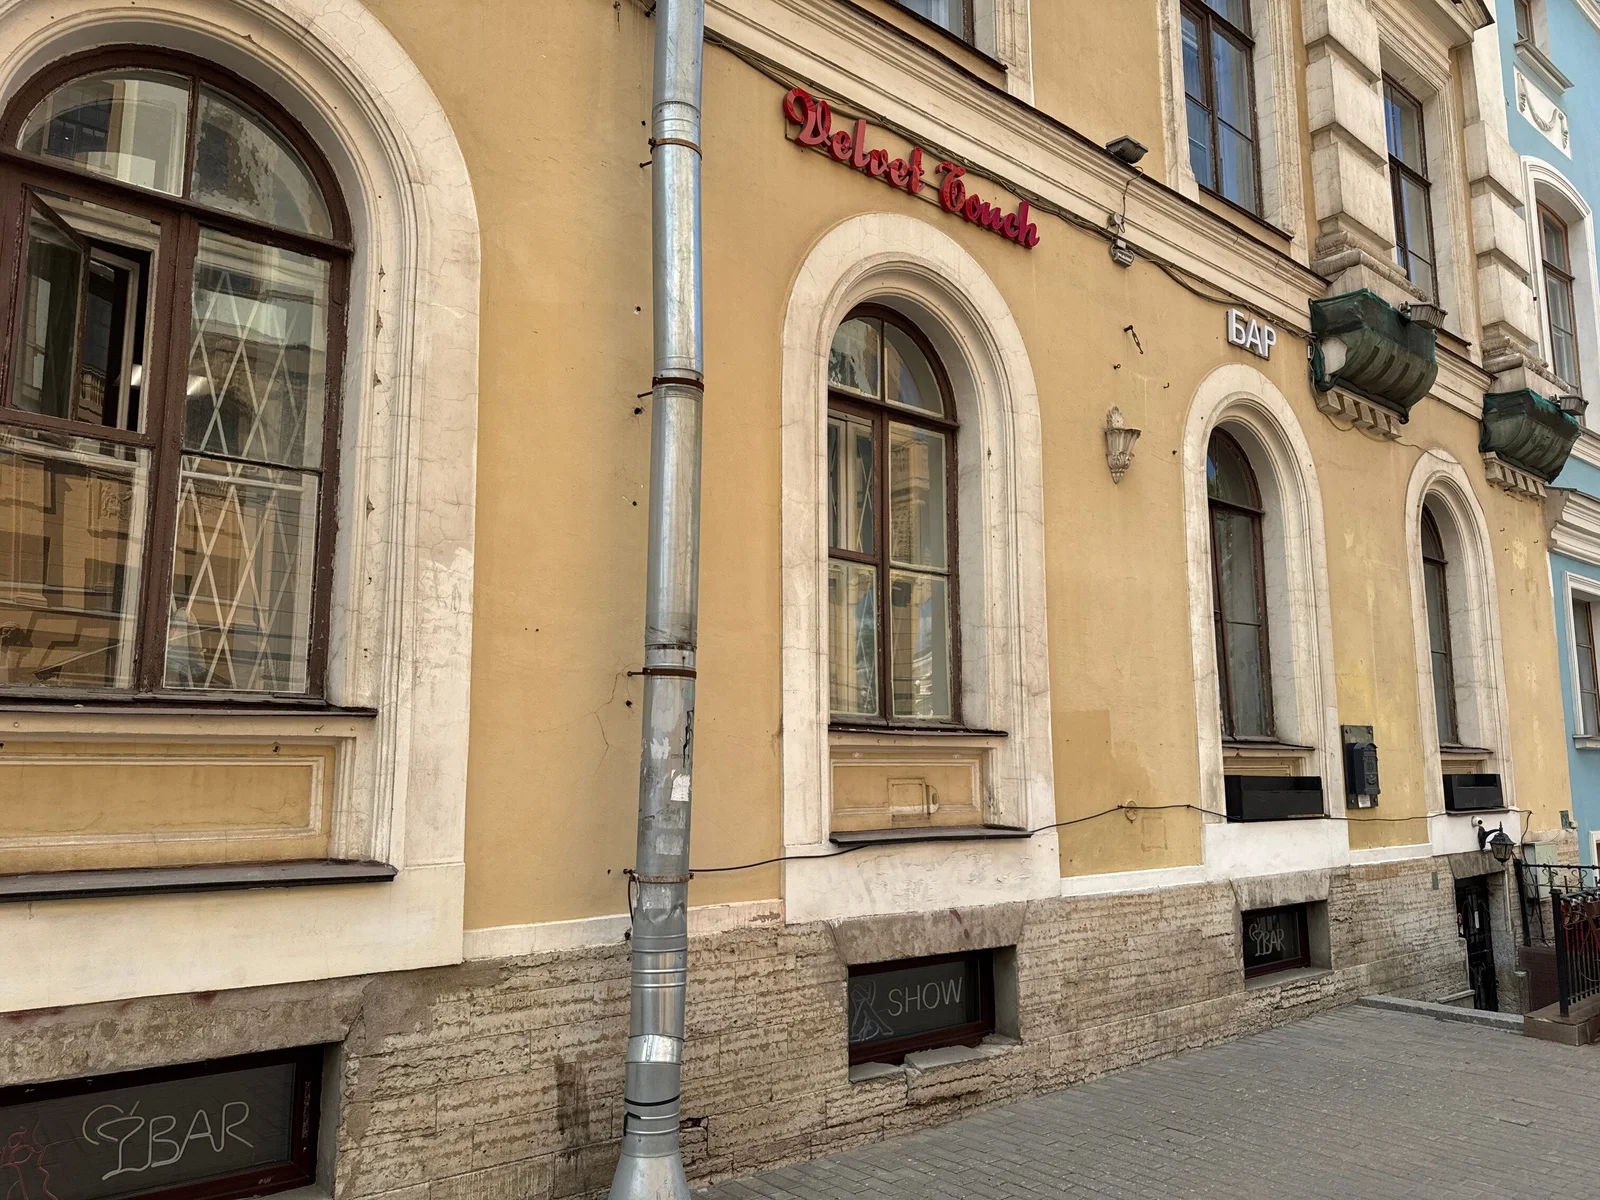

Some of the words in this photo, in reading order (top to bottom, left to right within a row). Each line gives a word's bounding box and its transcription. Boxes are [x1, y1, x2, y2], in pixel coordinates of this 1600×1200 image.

[783, 87, 925, 195] Velvet
[935, 161, 1040, 249] Touch
[1227, 308, 1277, 359] БАР
[1262, 928, 1287, 955] BAR
[887, 976, 963, 1017] SHOW
[148, 1101, 254, 1167] BAR
